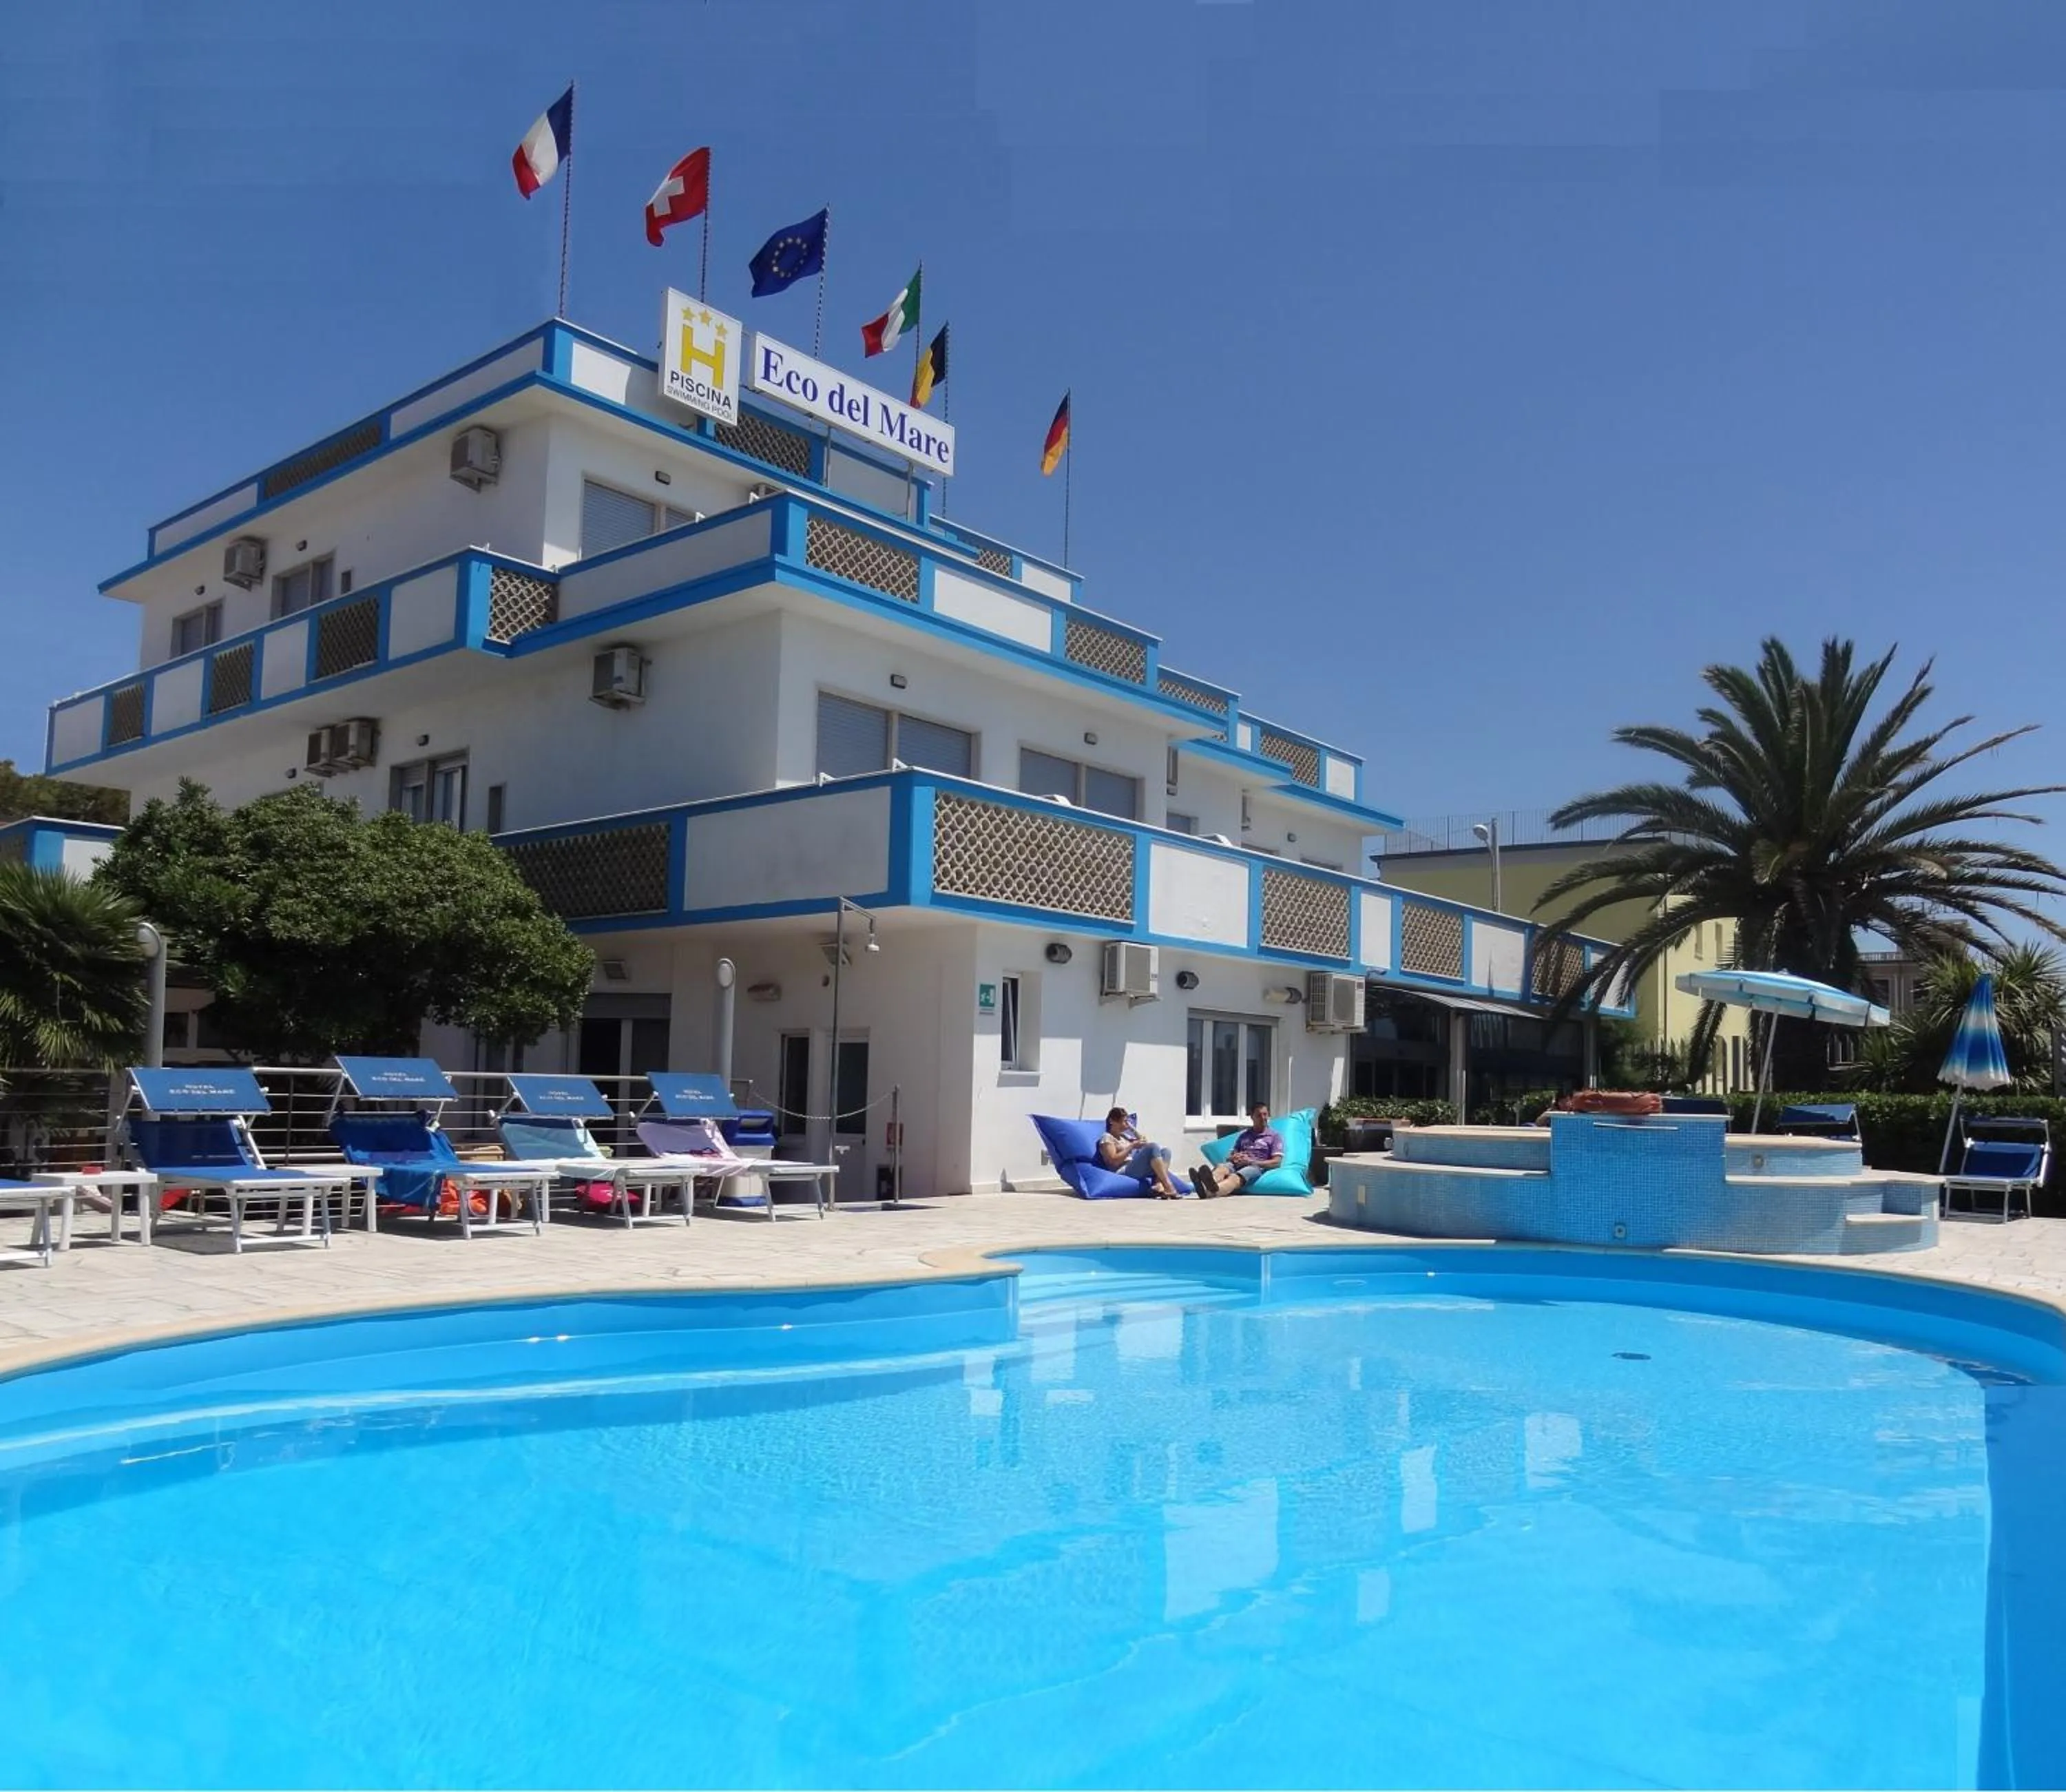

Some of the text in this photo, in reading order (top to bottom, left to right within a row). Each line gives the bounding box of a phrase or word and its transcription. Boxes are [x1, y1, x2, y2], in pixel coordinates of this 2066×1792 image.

[680, 324, 725, 390] H
[670, 370, 732, 410] PISCINA
[711, 404, 733, 421] POOL
[760, 346, 950, 463] Eco del Mare
